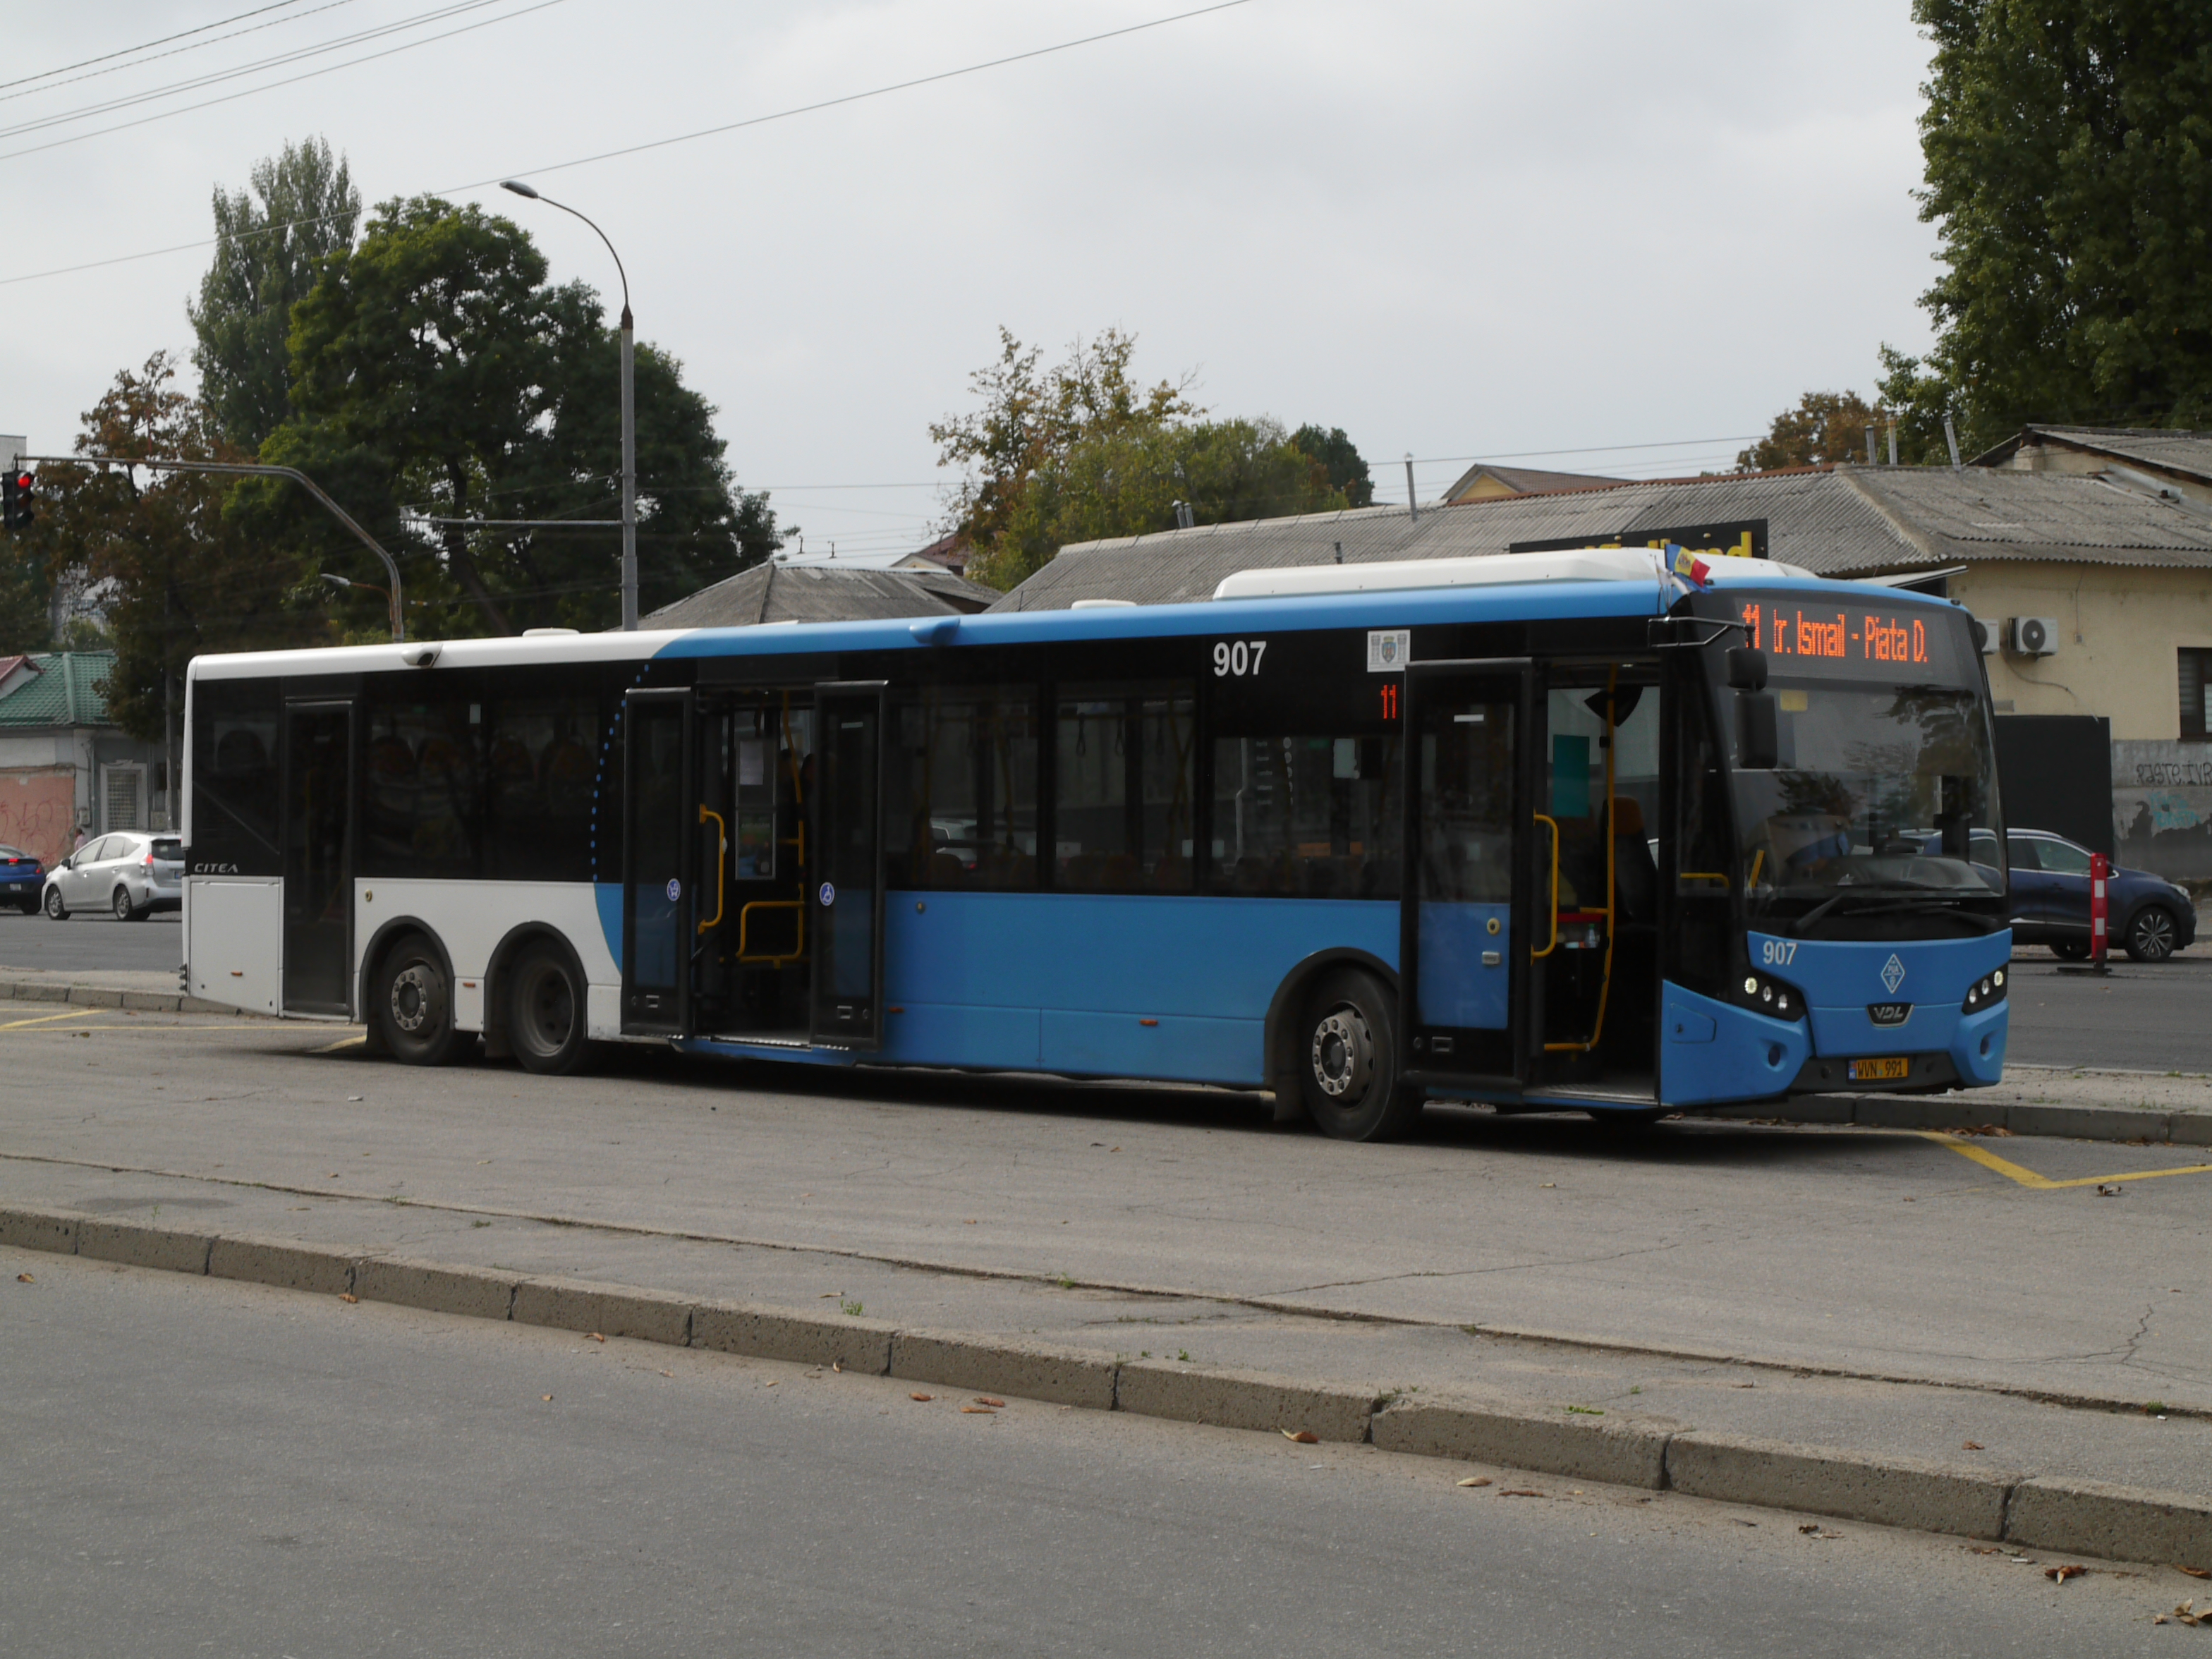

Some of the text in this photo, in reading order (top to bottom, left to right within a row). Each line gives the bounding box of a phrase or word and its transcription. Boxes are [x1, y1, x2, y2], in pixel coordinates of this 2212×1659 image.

[1742, 604, 1761, 649] 11
[1797, 610, 1845, 657] Ismail
[1865, 615, 1909, 662] Piata
[1914, 619, 1928, 663] D.
[1213, 640, 1267, 676] 907
[1380, 684, 1397, 719] 11
[194, 862, 239, 874] CITEA
[1763, 940, 1798, 966] 907
[1873, 1005, 1904, 1020] VDL
[1857, 1060, 1877, 1078] WVN
[1885, 1060, 1903, 1077] 991
